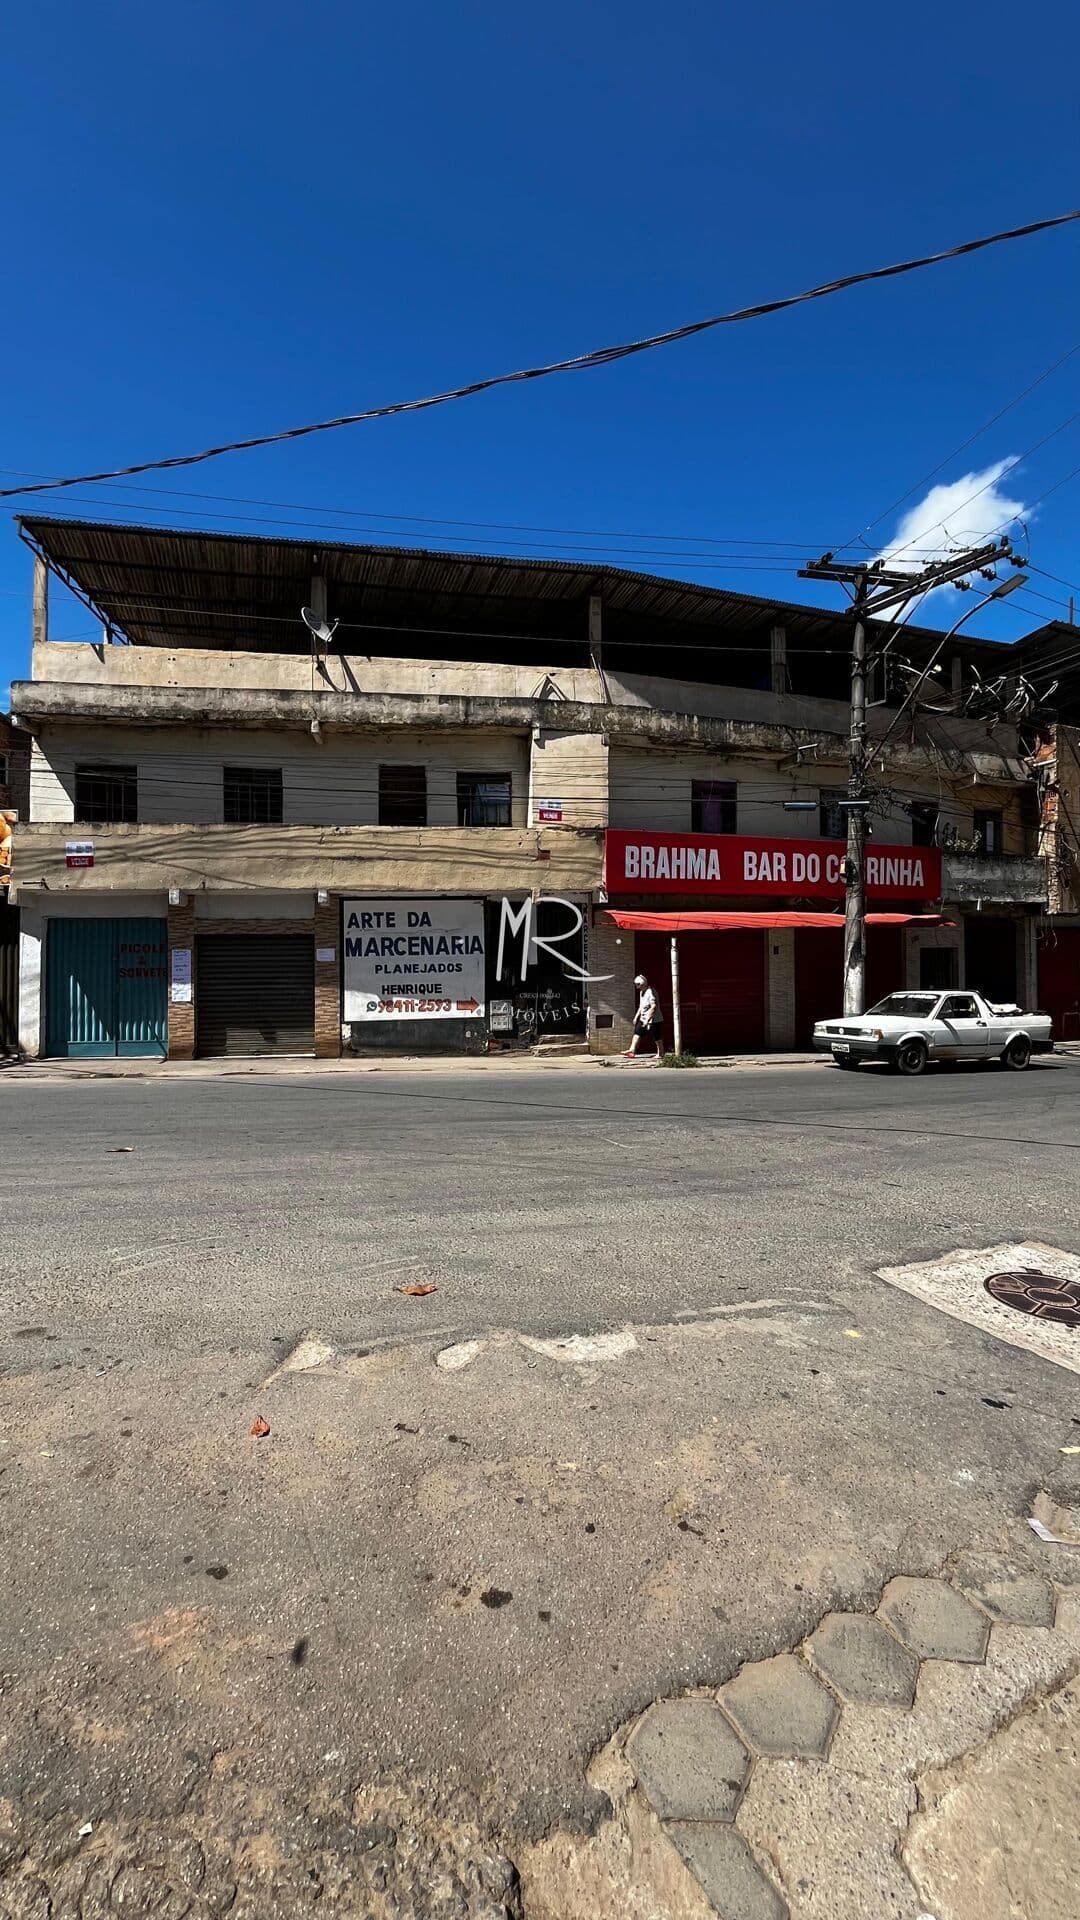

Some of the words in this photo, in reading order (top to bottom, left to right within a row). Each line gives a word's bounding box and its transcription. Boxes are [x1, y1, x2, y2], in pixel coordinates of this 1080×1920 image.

[625, 845, 721, 881] BRAHMA
[743, 851, 787, 882] BAR
[792, 852, 821, 884] DO
[827, 855, 925, 887] CRINHA
[347, 912, 396, 929] ARTE
[407, 911, 432, 928] DA
[345, 935, 484, 957] MARCENARIA
[374, 963, 463, 975] PLANEJADOS
[381, 983, 443, 995] HENRIQUE
